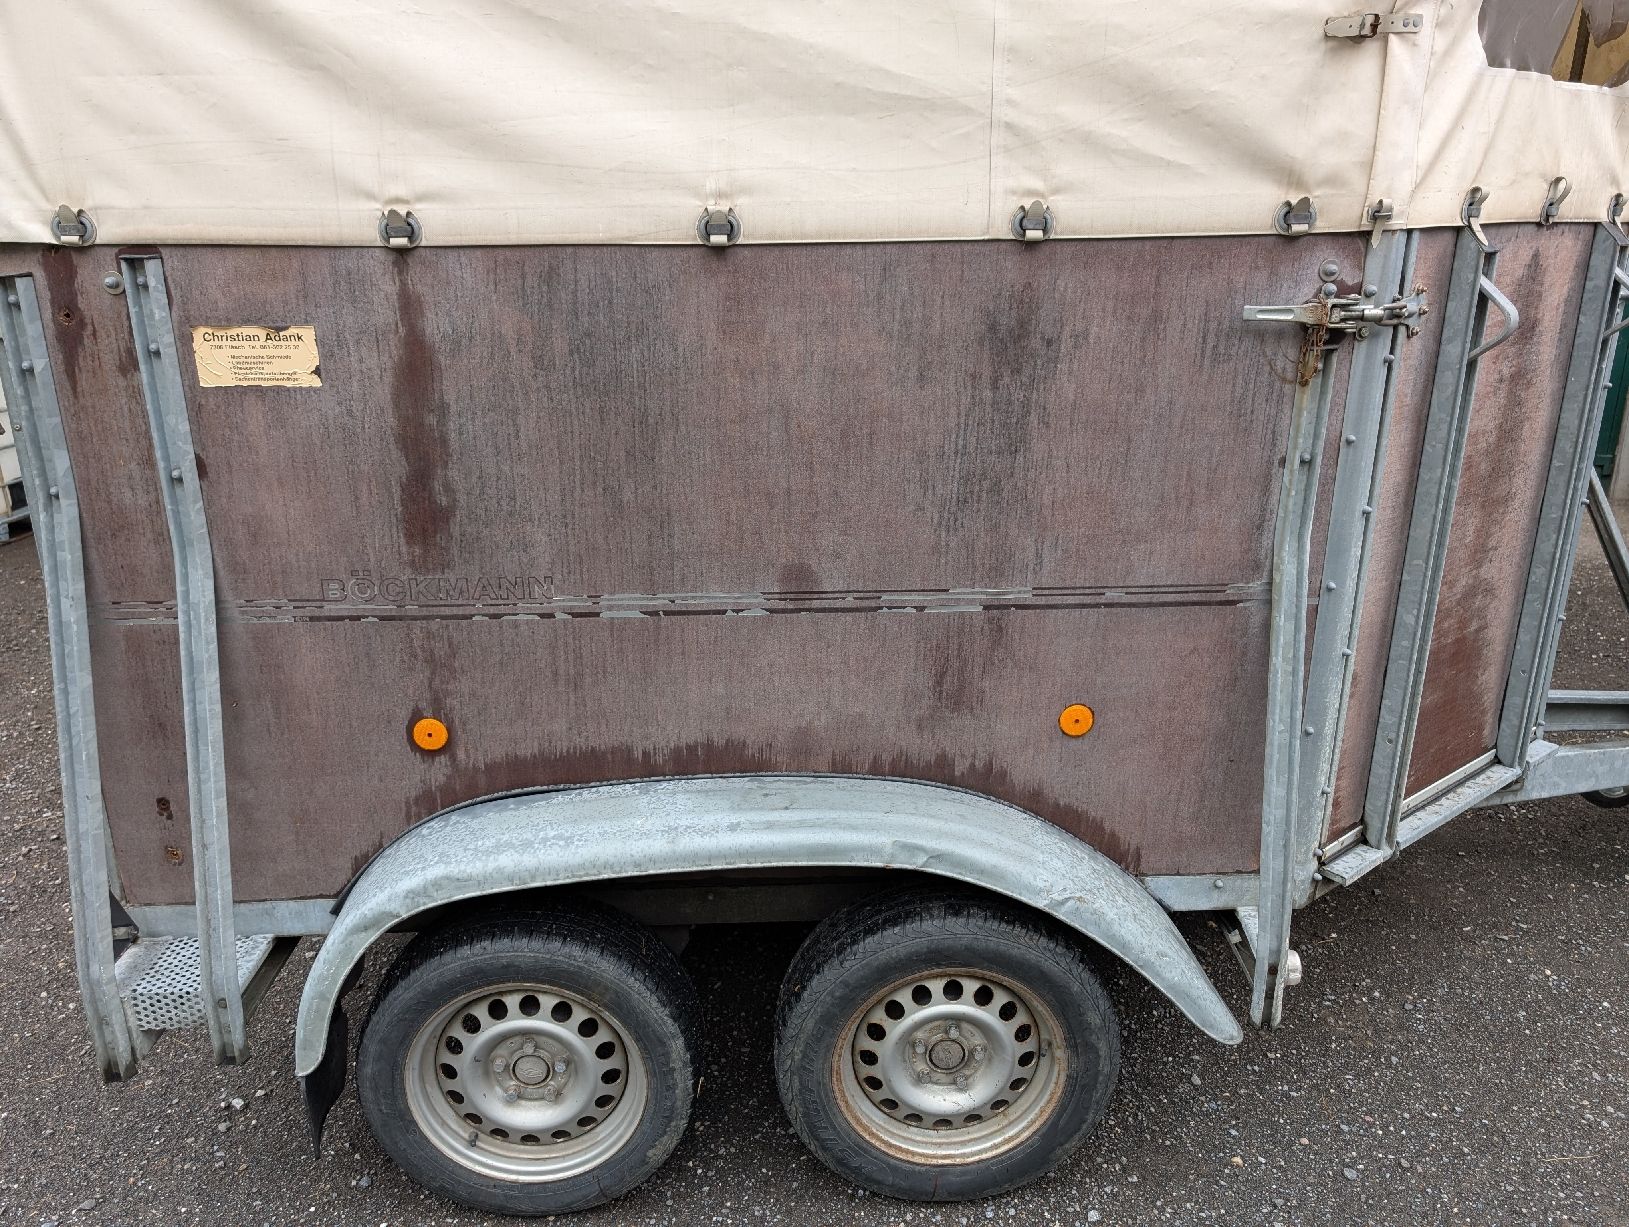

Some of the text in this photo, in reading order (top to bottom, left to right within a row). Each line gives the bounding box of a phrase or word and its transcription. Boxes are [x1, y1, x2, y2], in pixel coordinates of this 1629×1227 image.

[203, 332, 304, 342] Christian Adank
[320, 570, 554, 603] BÖCKMANN
